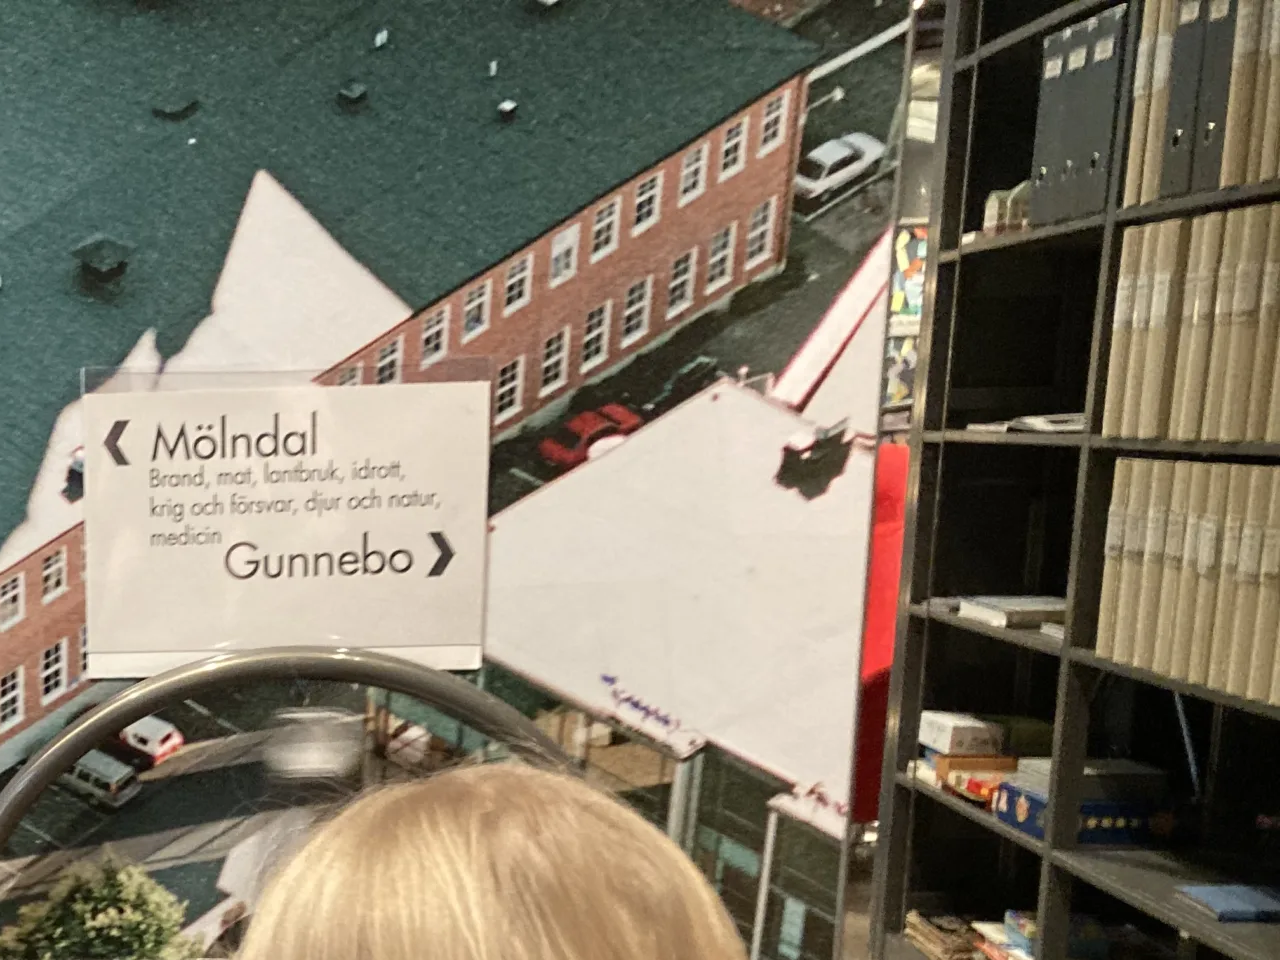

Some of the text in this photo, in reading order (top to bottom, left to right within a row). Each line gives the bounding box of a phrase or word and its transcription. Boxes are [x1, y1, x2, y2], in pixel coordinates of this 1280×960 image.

[151, 410, 318, 462] Mölndal
[148, 460, 406, 490] Brand, mat, lantbruk, idrott,
[148, 486, 441, 522] krig och försvar, djur och natur,
[149, 524, 222, 548] medicin
[224, 531, 415, 580] Gunnebo
